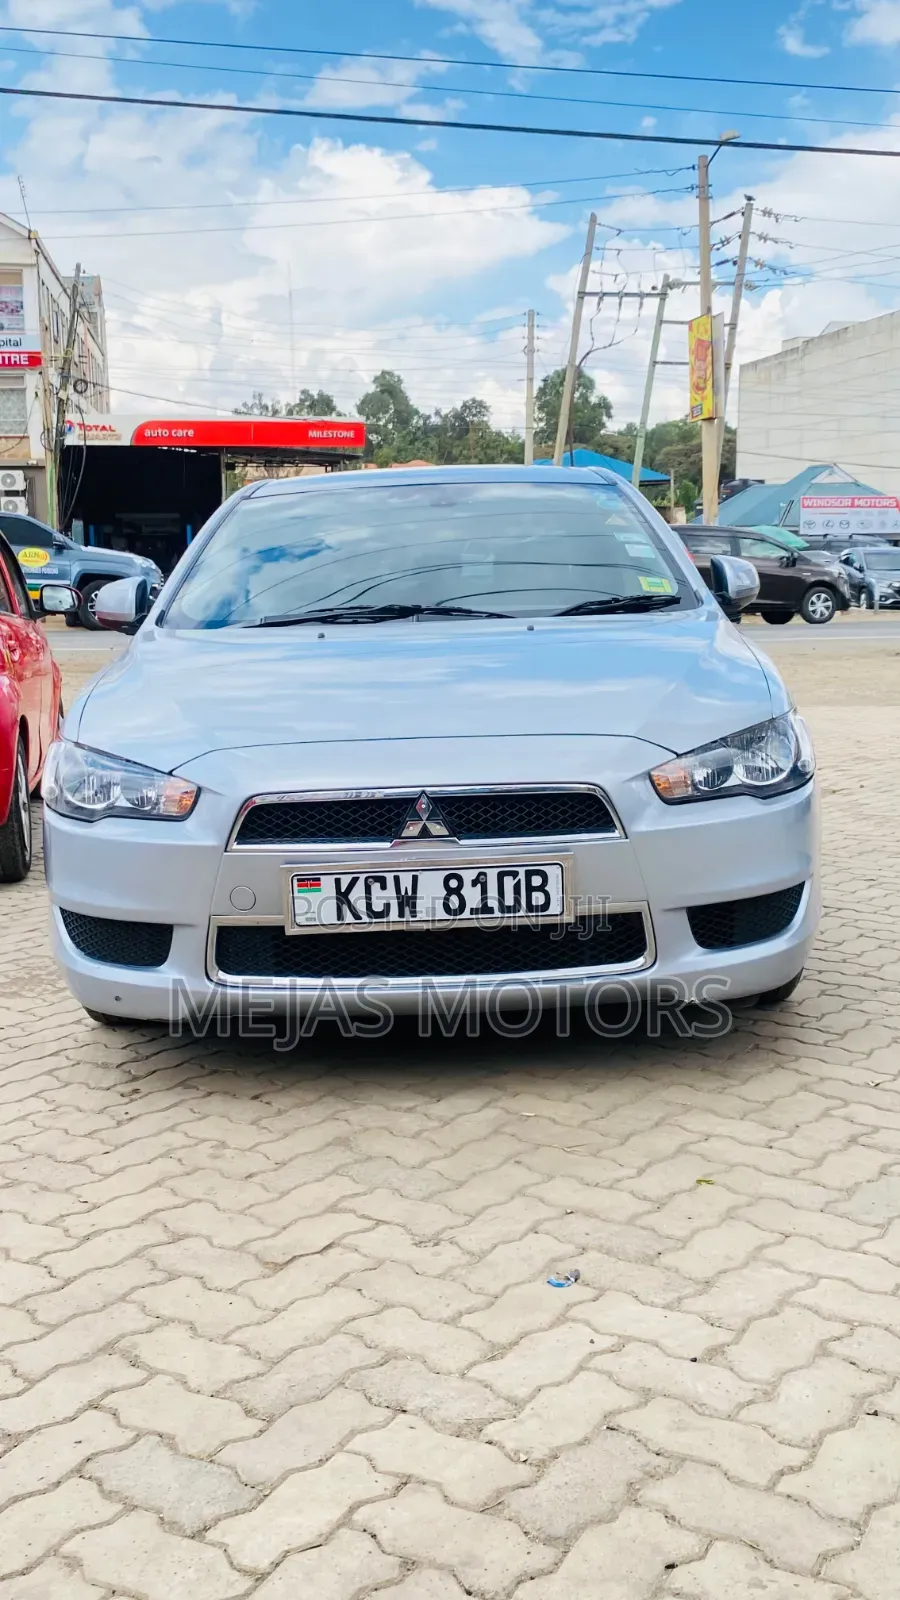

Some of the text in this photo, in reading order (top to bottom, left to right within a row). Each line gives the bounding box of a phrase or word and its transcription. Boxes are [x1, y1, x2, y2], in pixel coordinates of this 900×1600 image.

[0, 354, 29, 365] TRE
[77, 422, 116, 432] TOTAL
[144, 428, 195, 438] auto care
[308, 430, 355, 438] MILESTONE
[803, 498, 897, 507] WINDSOR MOTORS
[334, 873, 419, 922] KCW
[442, 868, 552, 916] 810B
